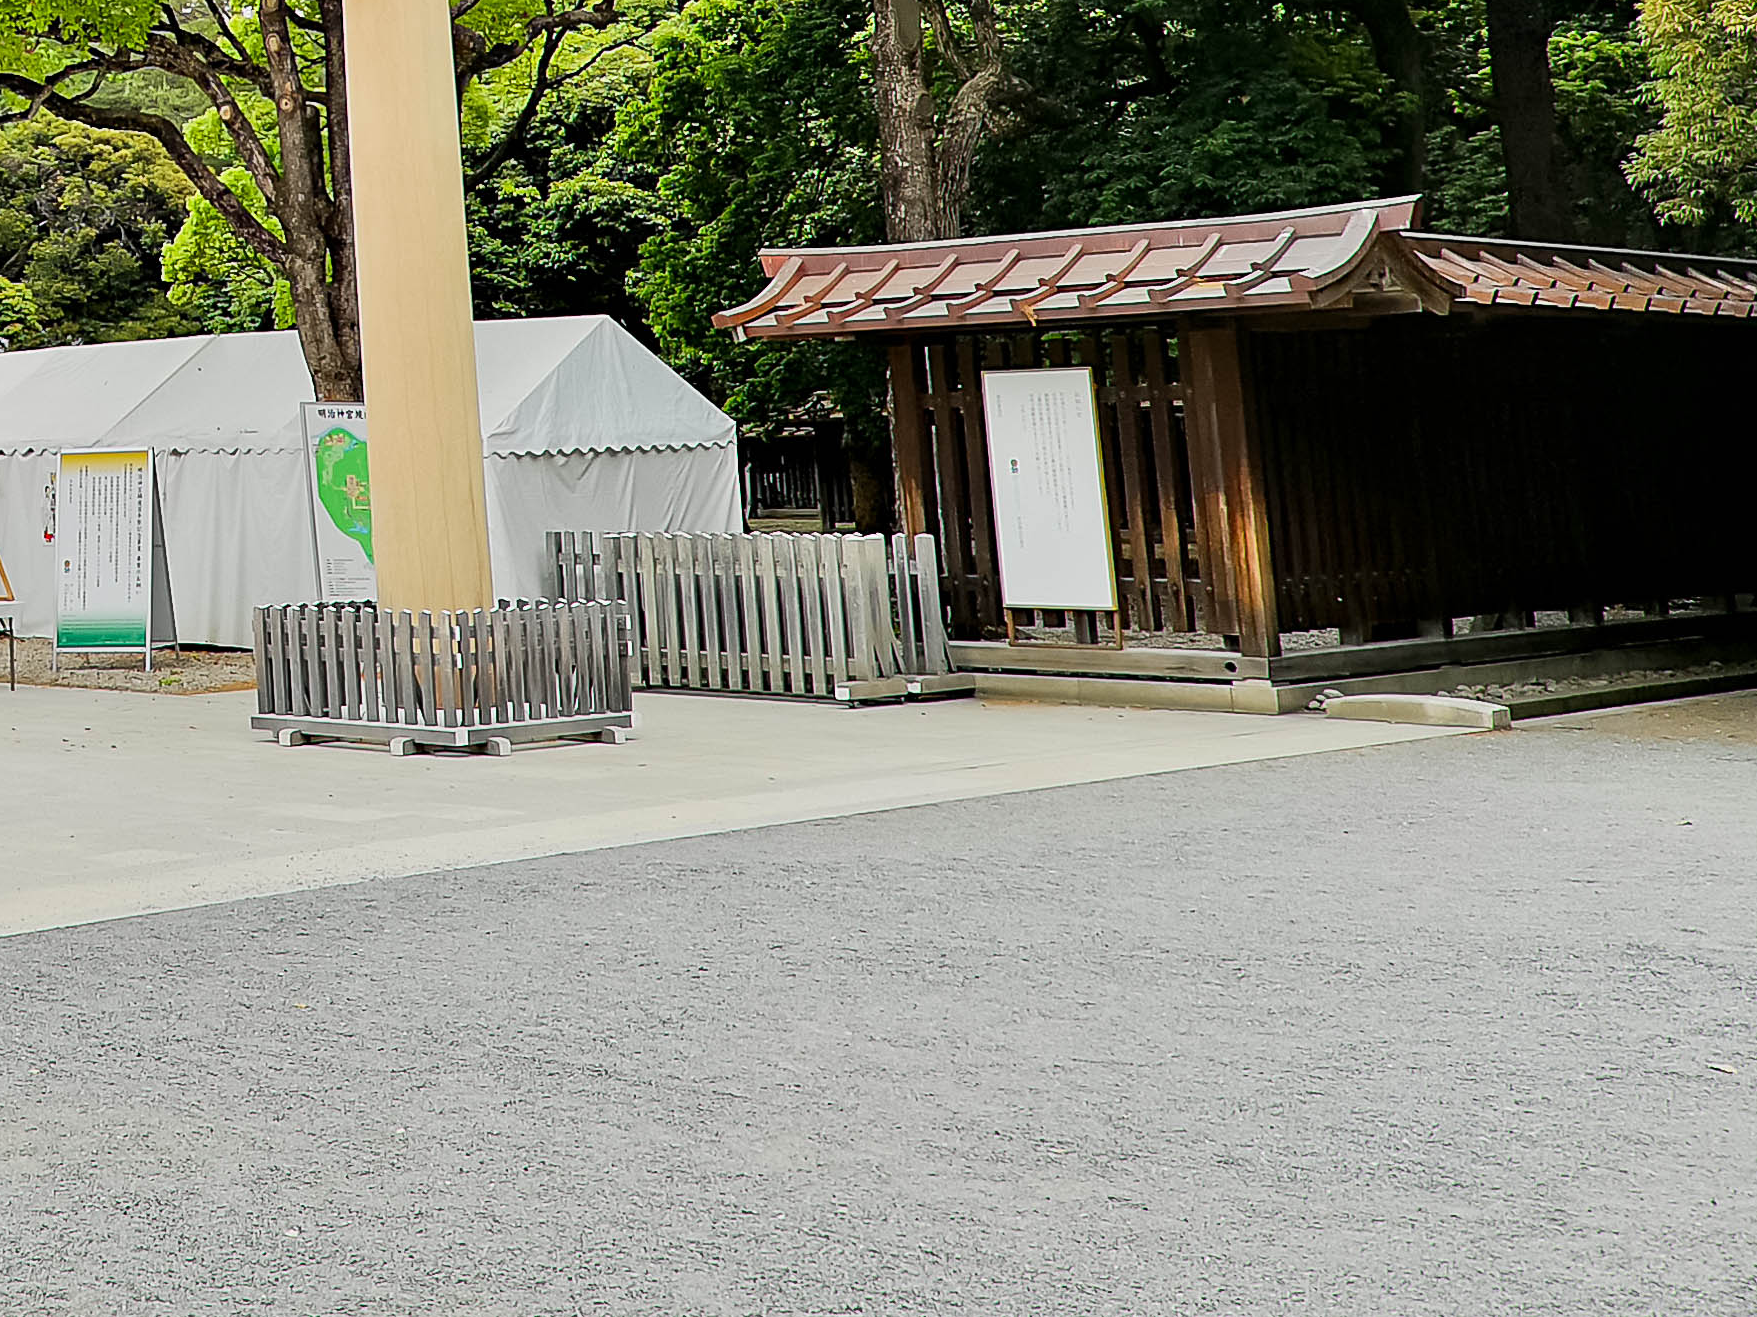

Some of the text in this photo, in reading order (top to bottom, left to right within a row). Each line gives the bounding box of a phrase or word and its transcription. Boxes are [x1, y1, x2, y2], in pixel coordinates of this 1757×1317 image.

[318, 409, 367, 419] 明治神宮境
